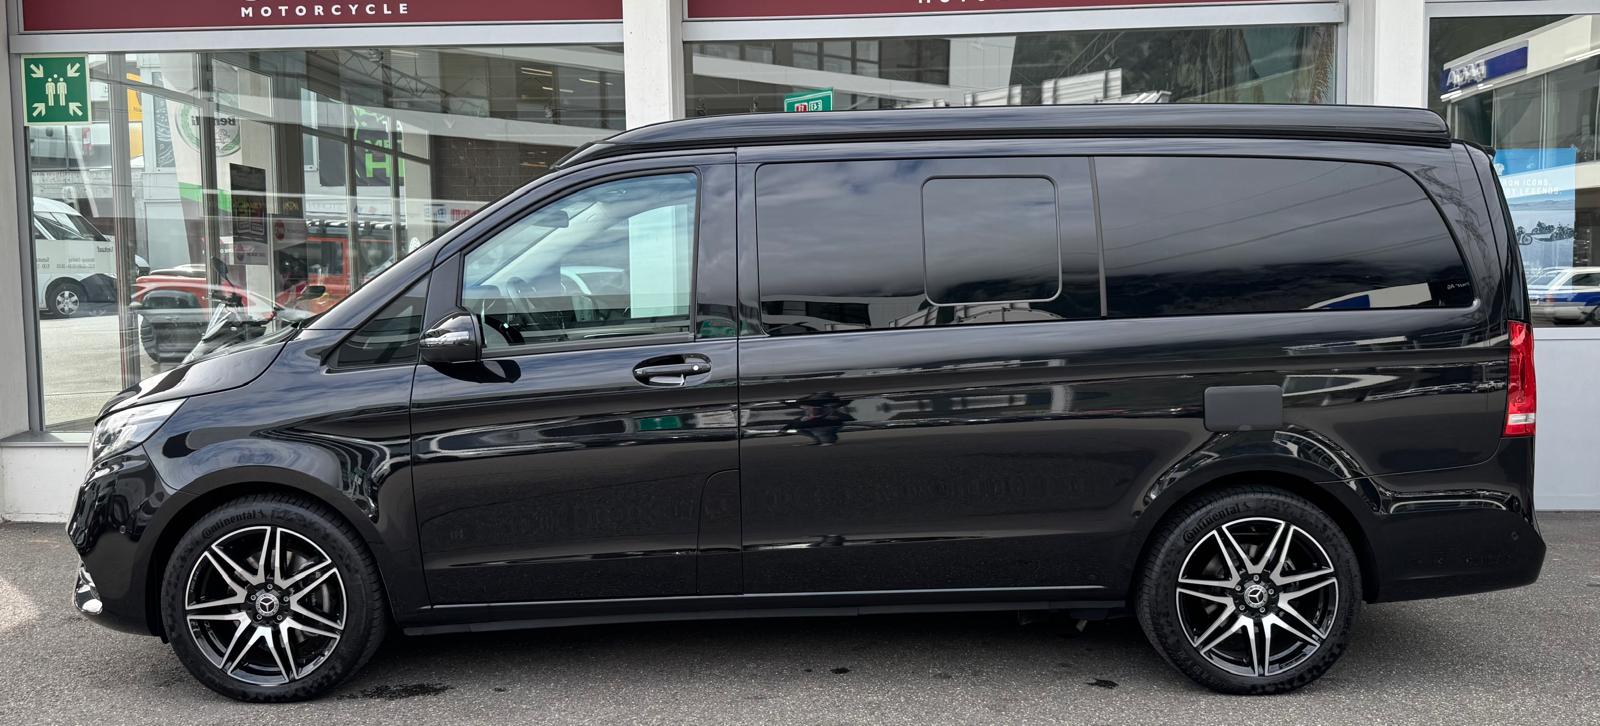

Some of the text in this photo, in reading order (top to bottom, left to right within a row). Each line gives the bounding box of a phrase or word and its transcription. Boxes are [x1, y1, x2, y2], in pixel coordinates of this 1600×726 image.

[240, 4, 408, 17] MOTORCYCLE
[201, 510, 257, 539] Continental
[1183, 504, 1240, 543] Continental
